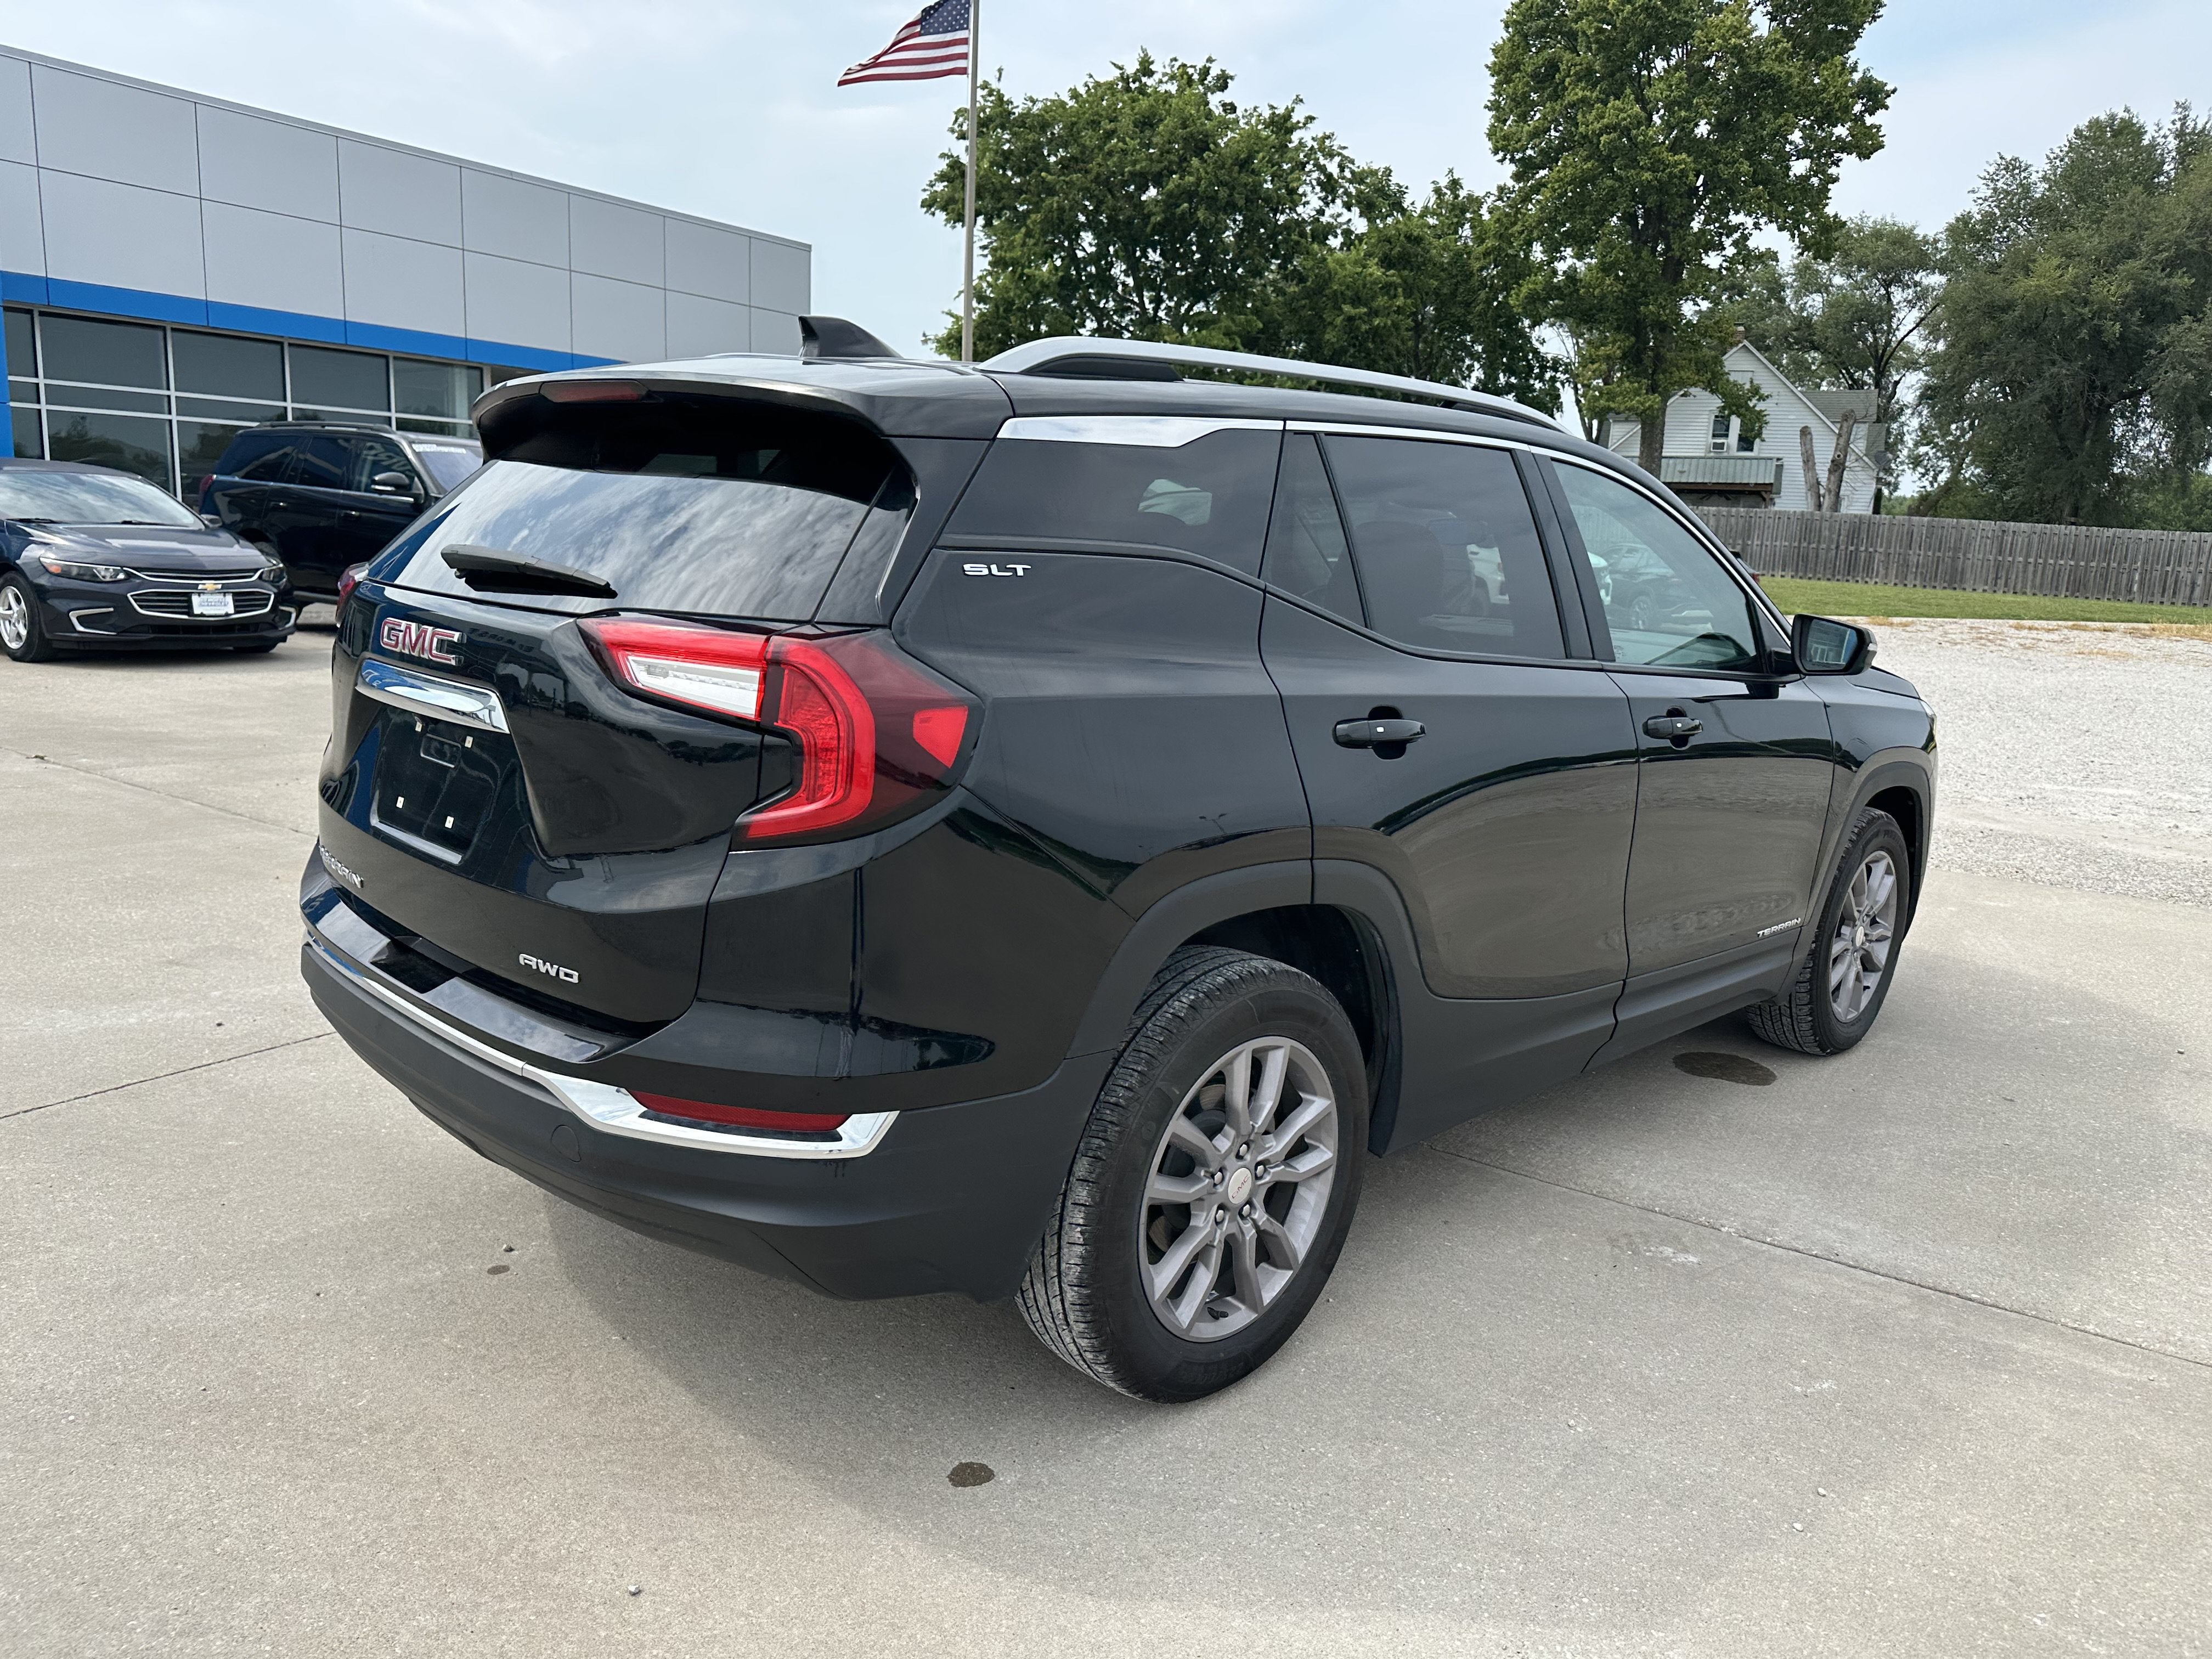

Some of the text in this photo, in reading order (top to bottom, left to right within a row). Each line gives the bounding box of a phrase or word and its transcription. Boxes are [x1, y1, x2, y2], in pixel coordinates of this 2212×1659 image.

[963, 563, 1031, 576] SLT
[380, 617, 463, 666] GMC
[1757, 917, 1801, 938] TERRAIN
[519, 953, 579, 983] AWD
[1232, 1173, 1251, 1199] GMC
